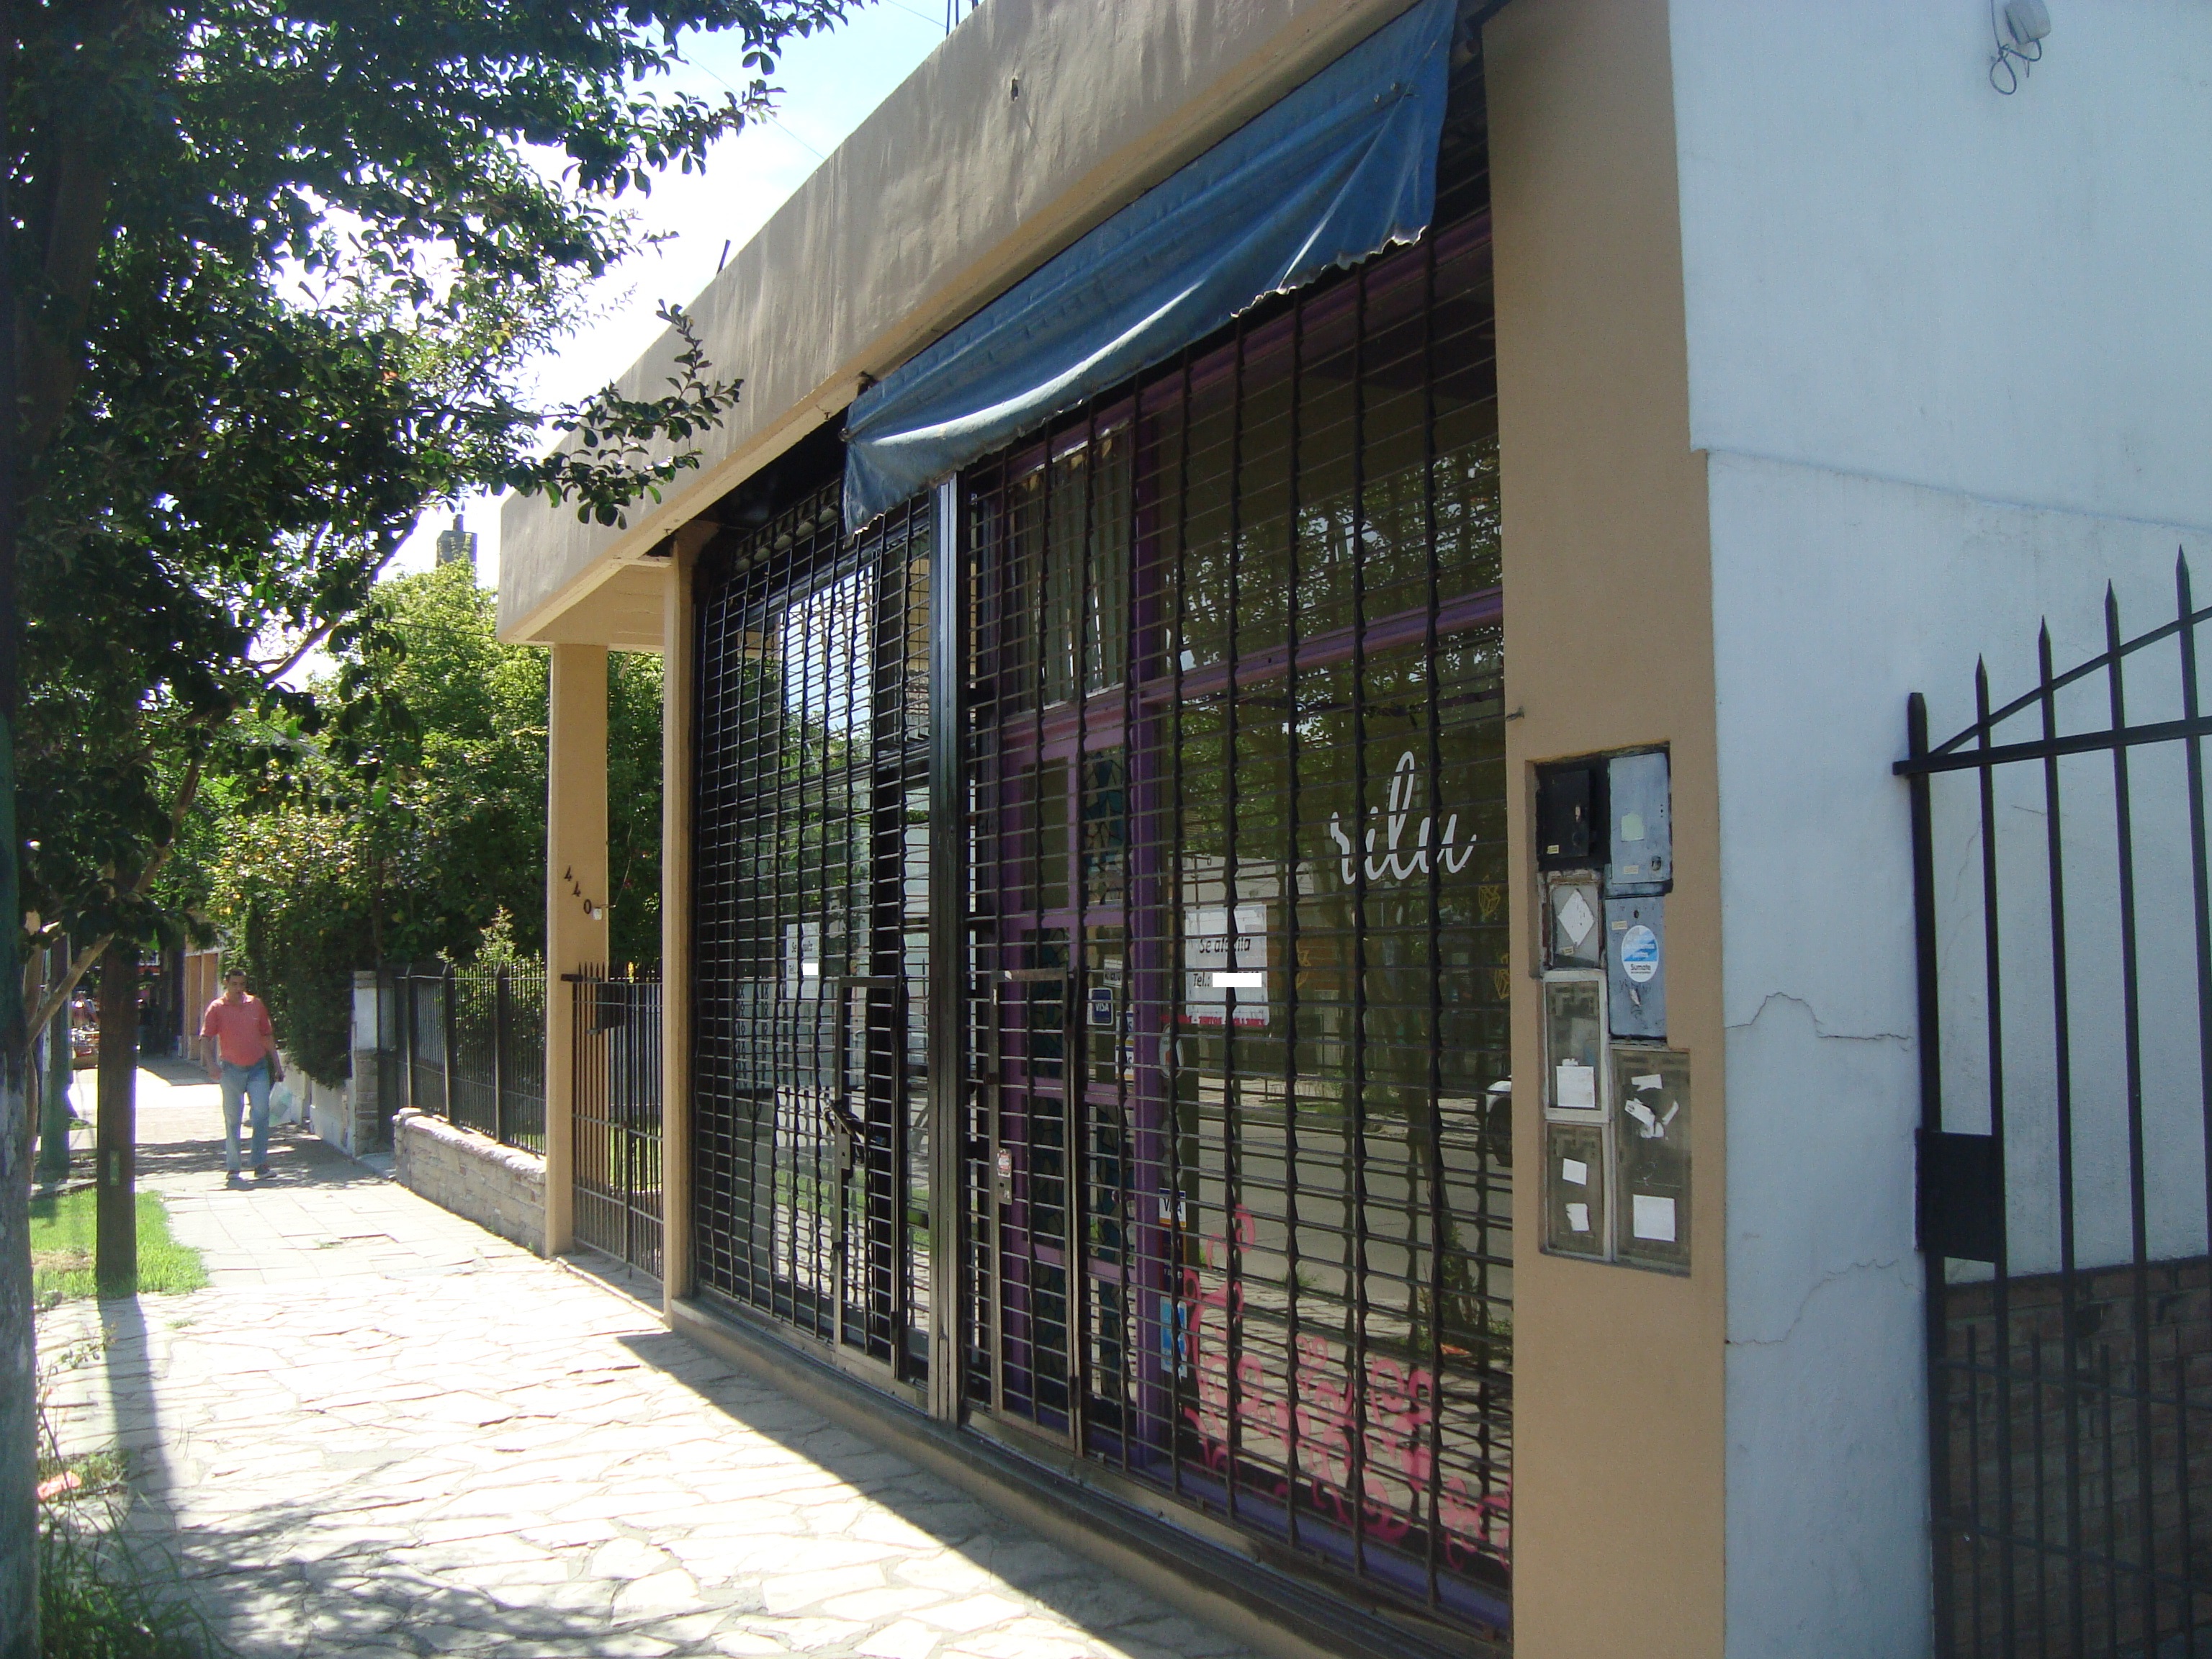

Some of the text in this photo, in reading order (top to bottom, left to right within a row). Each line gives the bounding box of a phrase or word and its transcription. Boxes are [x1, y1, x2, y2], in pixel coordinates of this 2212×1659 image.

[1200, 937, 1251, 953] Se alila
[1095, 1002, 1110, 1012] VISA
